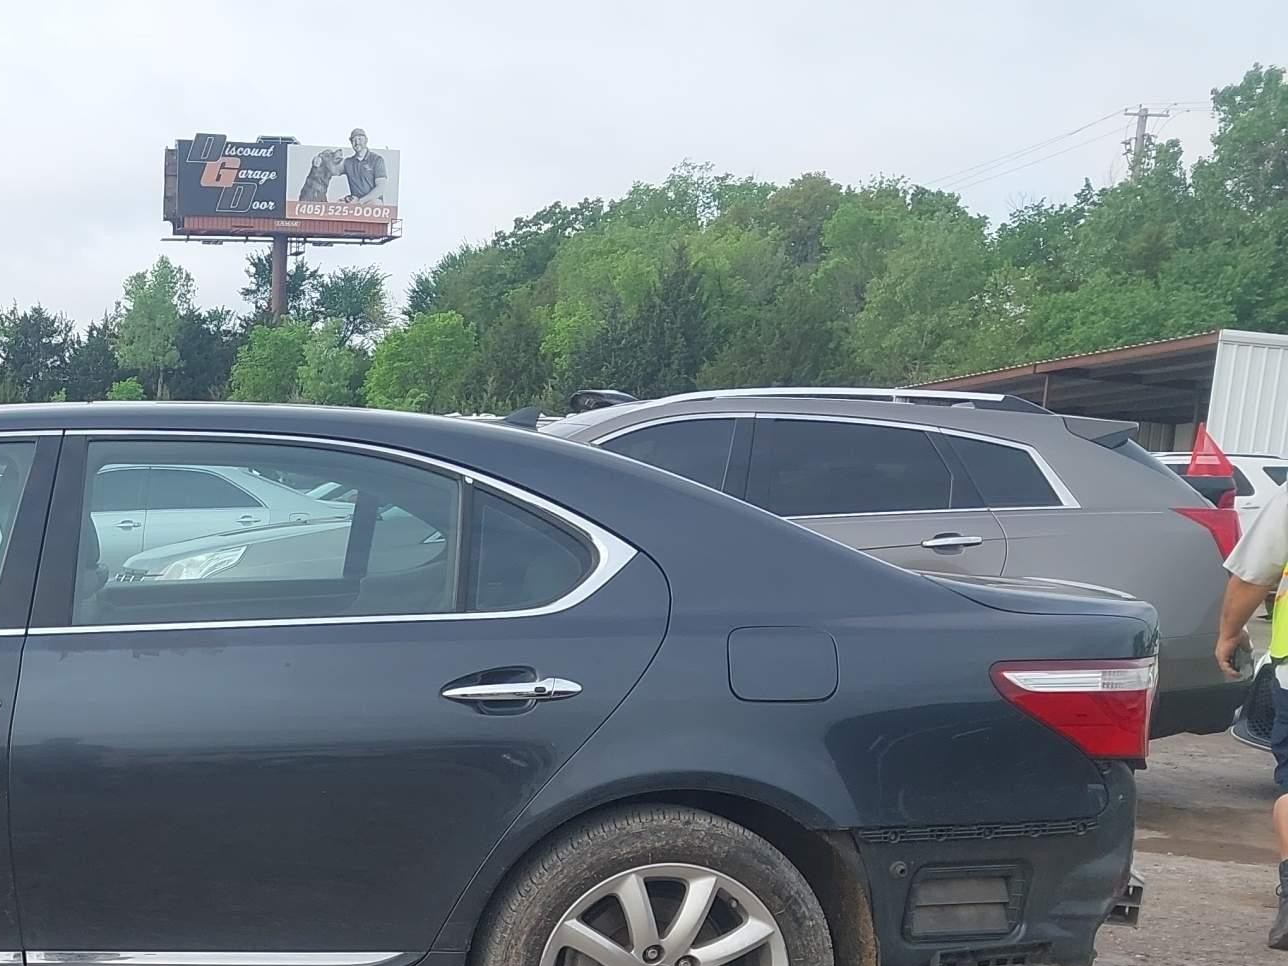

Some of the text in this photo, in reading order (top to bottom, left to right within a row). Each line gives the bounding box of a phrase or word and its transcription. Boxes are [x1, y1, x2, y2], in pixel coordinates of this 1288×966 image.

[186, 133, 275, 163] Discount
[200, 157, 278, 188] Garage
[216, 182, 275, 212] Door
[295, 204, 391, 218] (405) 525-DOOR
